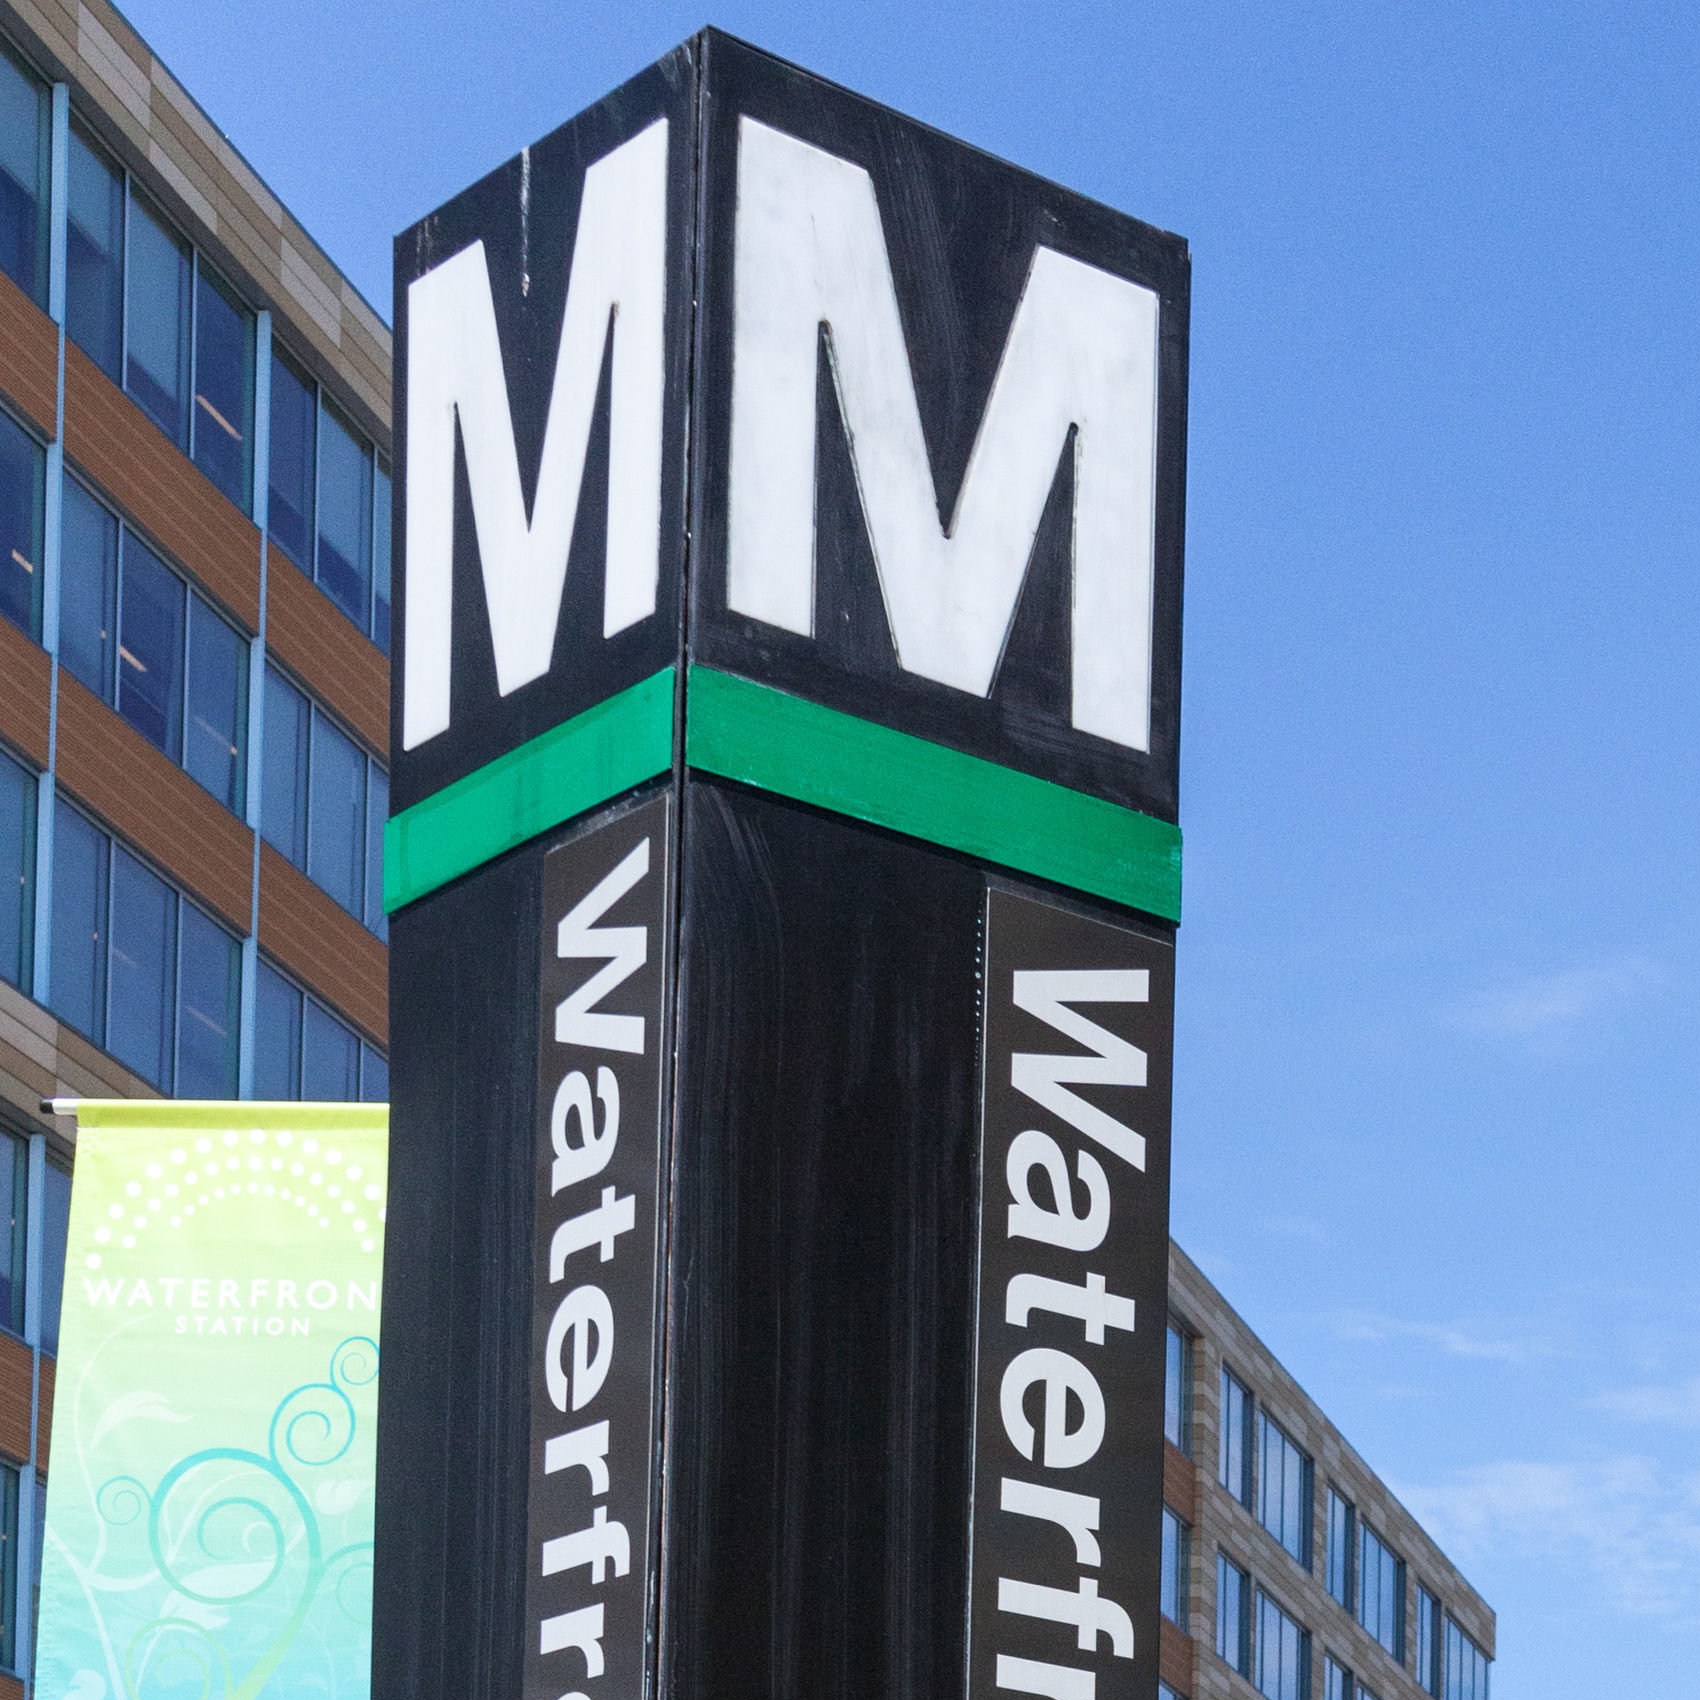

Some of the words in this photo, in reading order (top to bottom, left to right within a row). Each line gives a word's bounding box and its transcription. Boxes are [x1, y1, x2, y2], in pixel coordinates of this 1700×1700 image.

[404, 118, 668, 751] M
[727, 116, 1159, 754] M
[83, 1277, 377, 1310] WATERFRON
[175, 1316, 310, 1336] STATION
